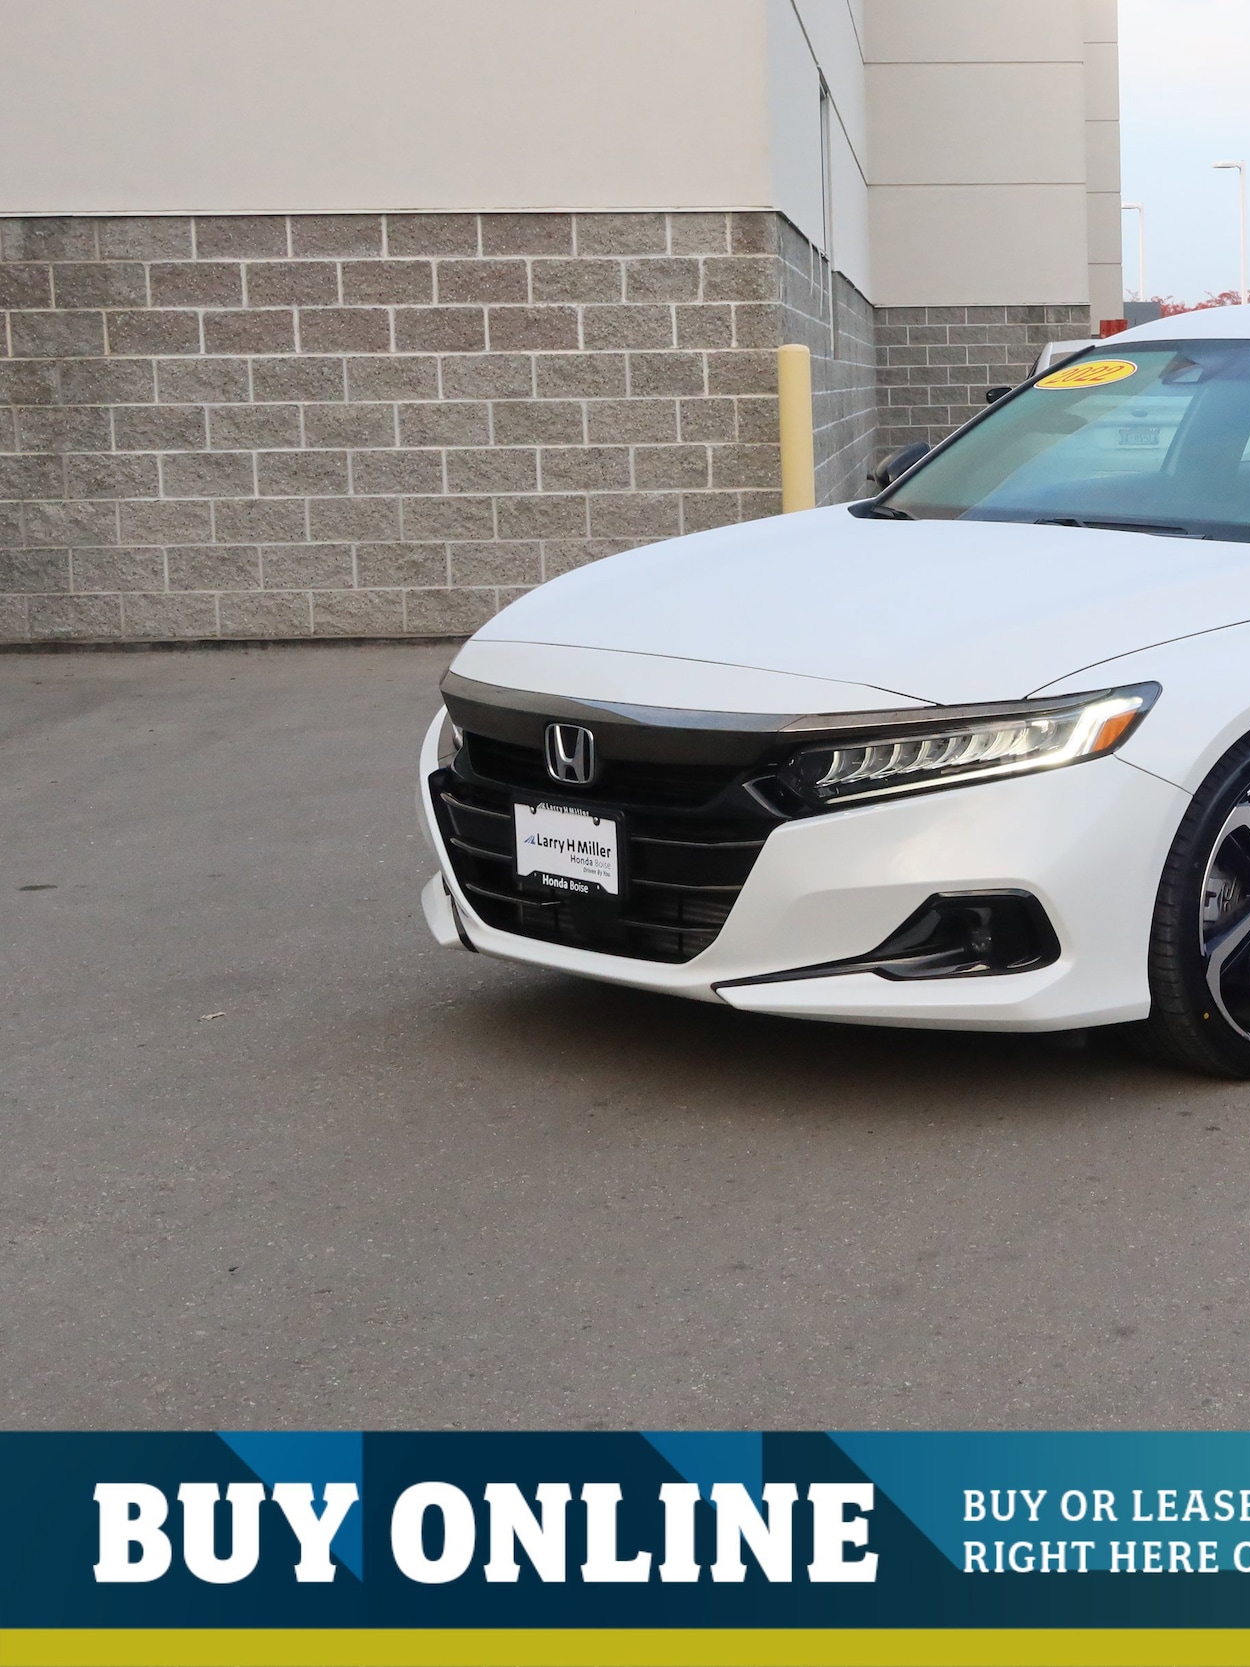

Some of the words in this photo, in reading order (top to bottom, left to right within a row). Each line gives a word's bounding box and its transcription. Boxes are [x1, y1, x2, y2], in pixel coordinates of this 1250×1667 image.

[1044, 365, 1125, 385] 2022
[536, 832, 565, 854] Larry
[566, 838, 575, 852] H
[577, 840, 611, 858] Miller
[570, 854, 594, 867] Honda
[594, 858, 611, 870] Boise
[541, 873, 569, 890] Honda
[569, 880, 589, 894] Boise
